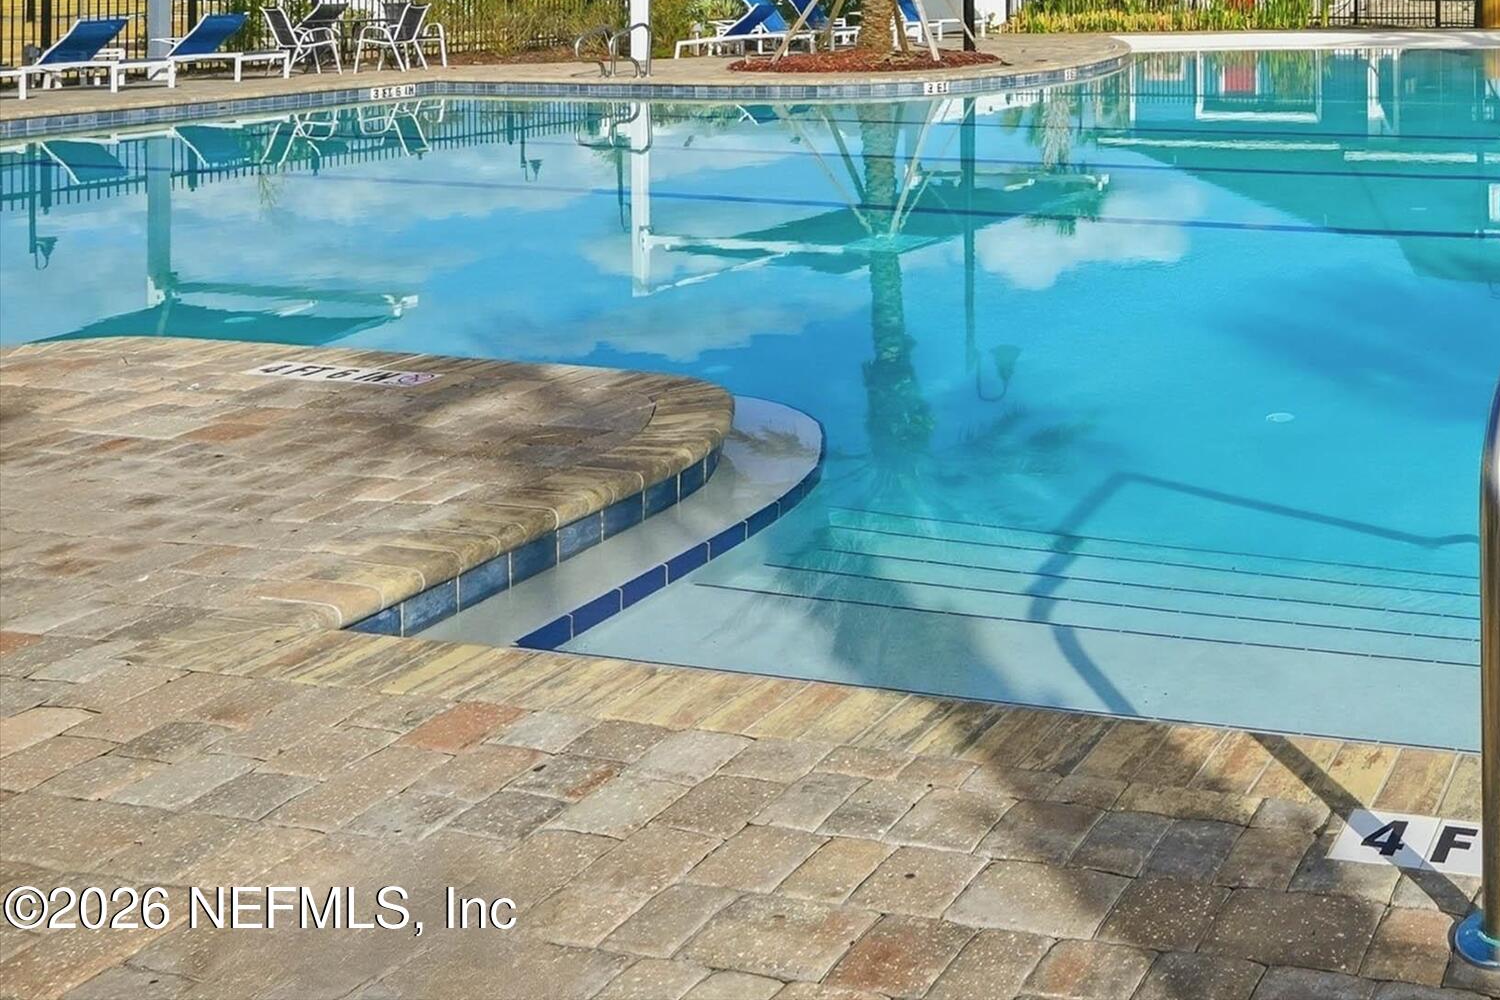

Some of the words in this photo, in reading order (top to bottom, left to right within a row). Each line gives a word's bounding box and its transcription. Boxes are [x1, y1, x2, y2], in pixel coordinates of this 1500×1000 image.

[373, 88, 379, 99] 3
[283, 365, 335, 376] FT
[326, 369, 359, 379] 6
[353, 371, 400, 382] IN
[1361, 820, 1409, 857] 4
